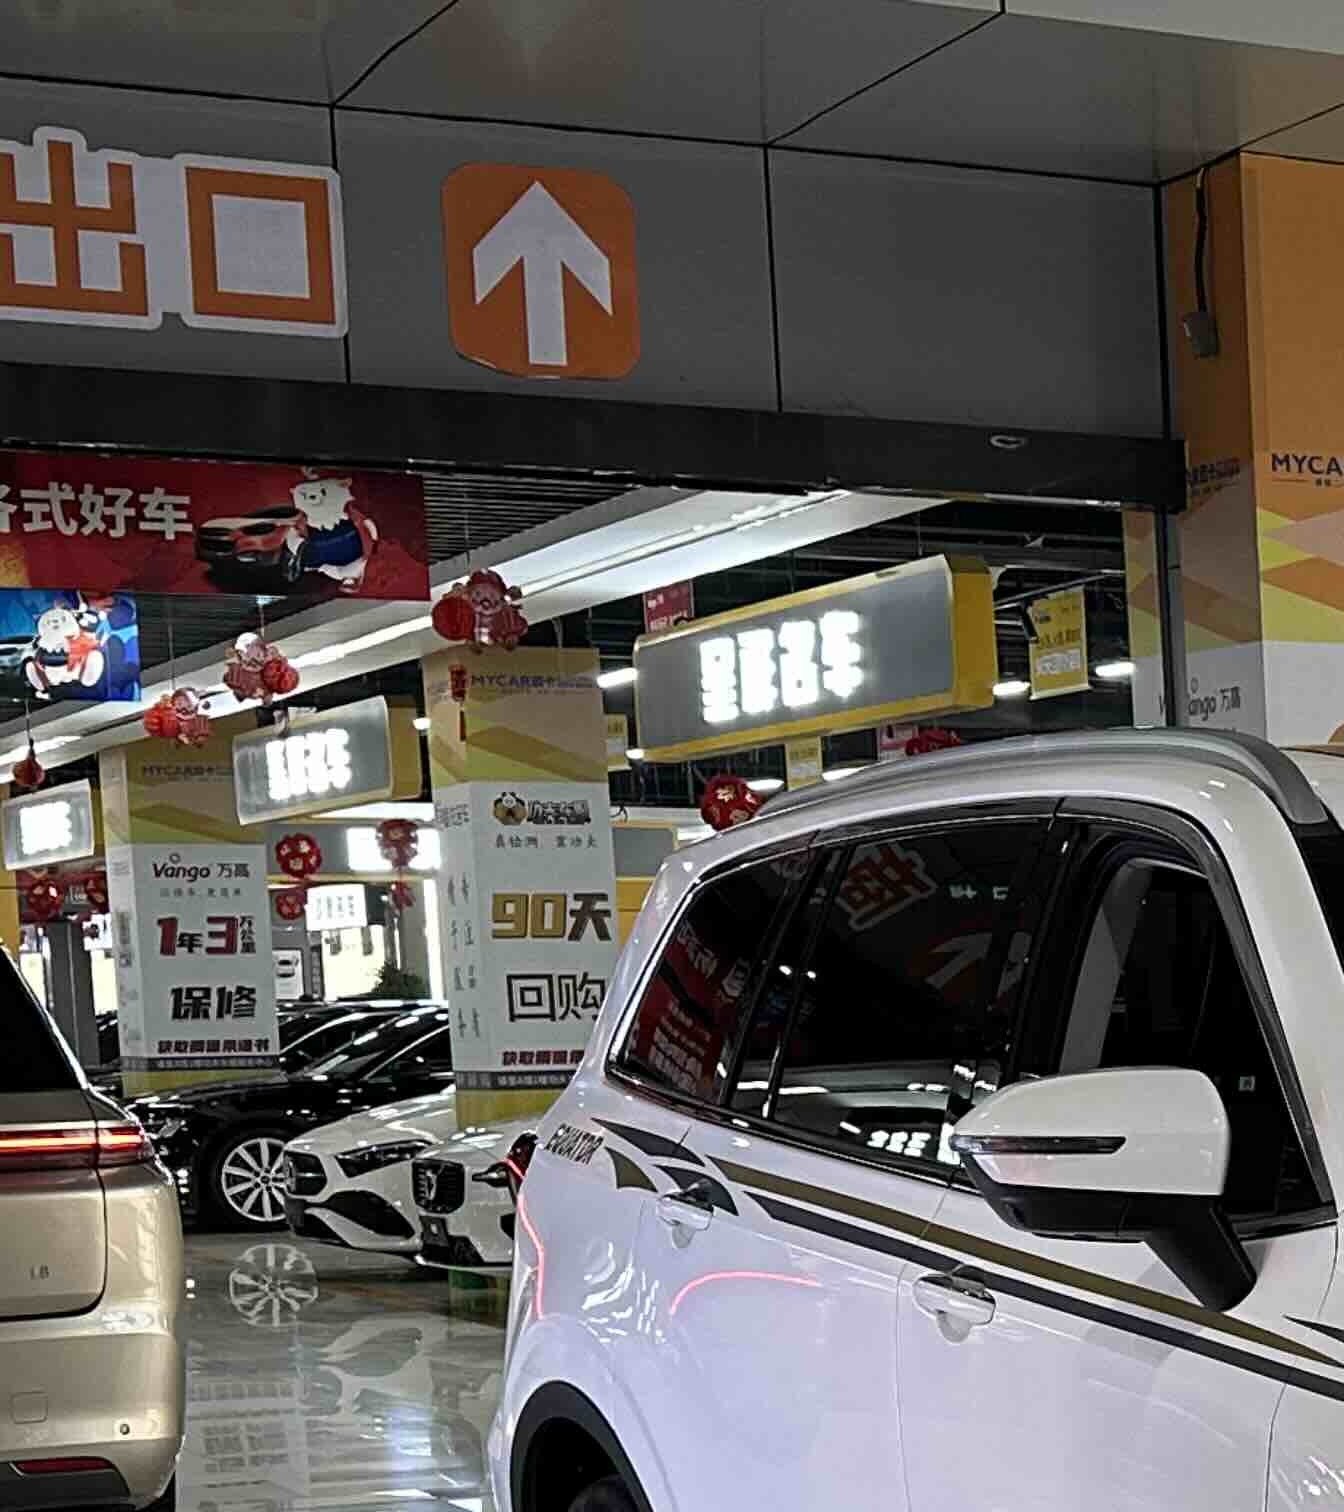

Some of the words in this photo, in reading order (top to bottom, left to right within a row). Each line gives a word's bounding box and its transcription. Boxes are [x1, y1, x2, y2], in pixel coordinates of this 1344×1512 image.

[0, 134, 341, 332] 出口
[0, 482, 193, 541] 式好车
[152, 860, 211, 882] Vango
[491, 892, 612, 941] 90天
[171, 985, 256, 1020] 保修
[505, 972, 606, 1023] 回购
